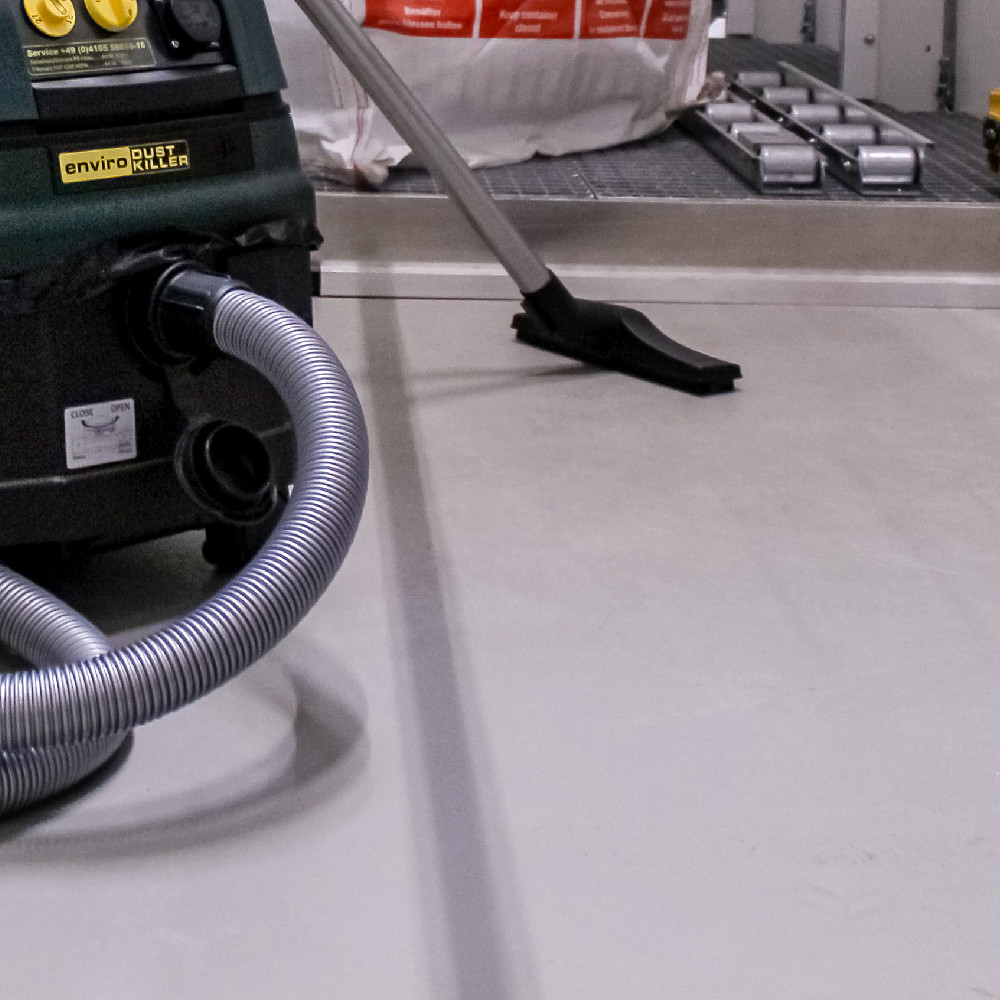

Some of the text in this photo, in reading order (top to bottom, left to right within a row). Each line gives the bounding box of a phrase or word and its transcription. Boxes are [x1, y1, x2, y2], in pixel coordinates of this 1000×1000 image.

[26, 47, 59, 58] Service
[131, 145, 175, 160] DUST
[65, 155, 128, 175] enviro
[133, 155, 189, 171] KILLER
